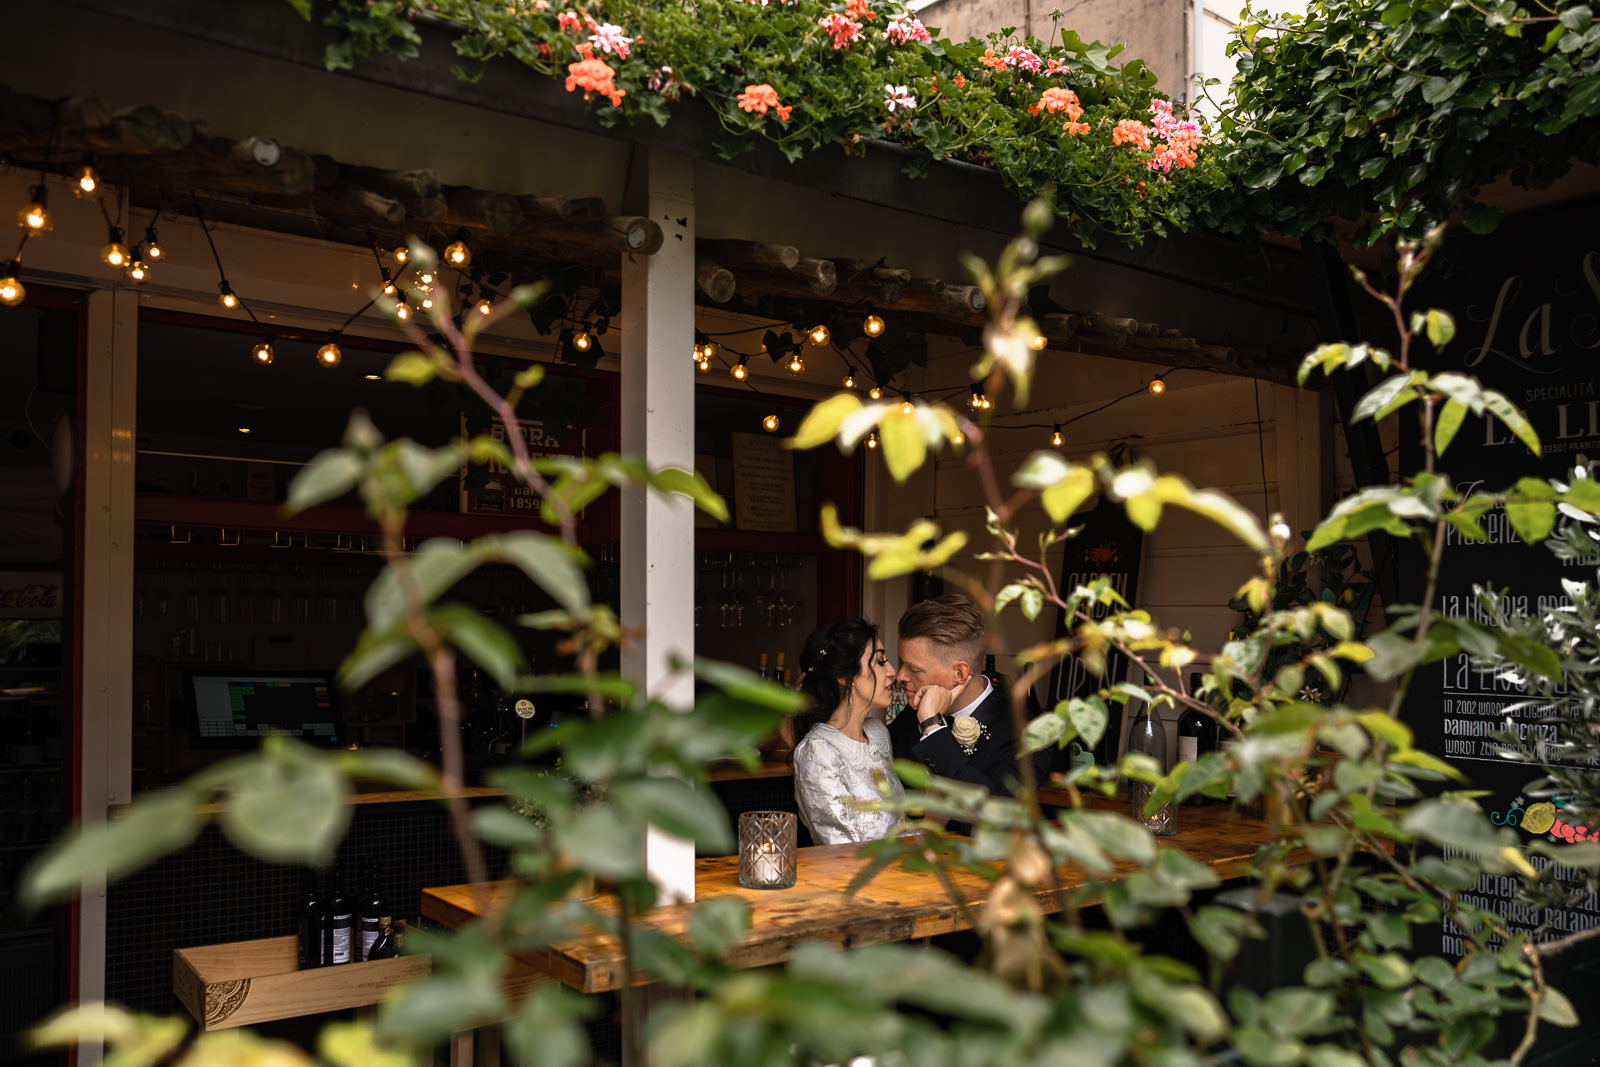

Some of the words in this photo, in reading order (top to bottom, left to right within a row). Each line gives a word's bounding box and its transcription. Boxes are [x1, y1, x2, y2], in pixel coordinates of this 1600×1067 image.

[1464, 274, 1561, 374] La
[1482, 409, 1533, 447] L
[509, 497, 540, 510] 1859
[1056, 651, 1119, 706] OPN
[1456, 699, 1477, 715] 2002
[1478, 701, 1506, 716] WORDT
[1445, 739, 1476, 755] WORDT
